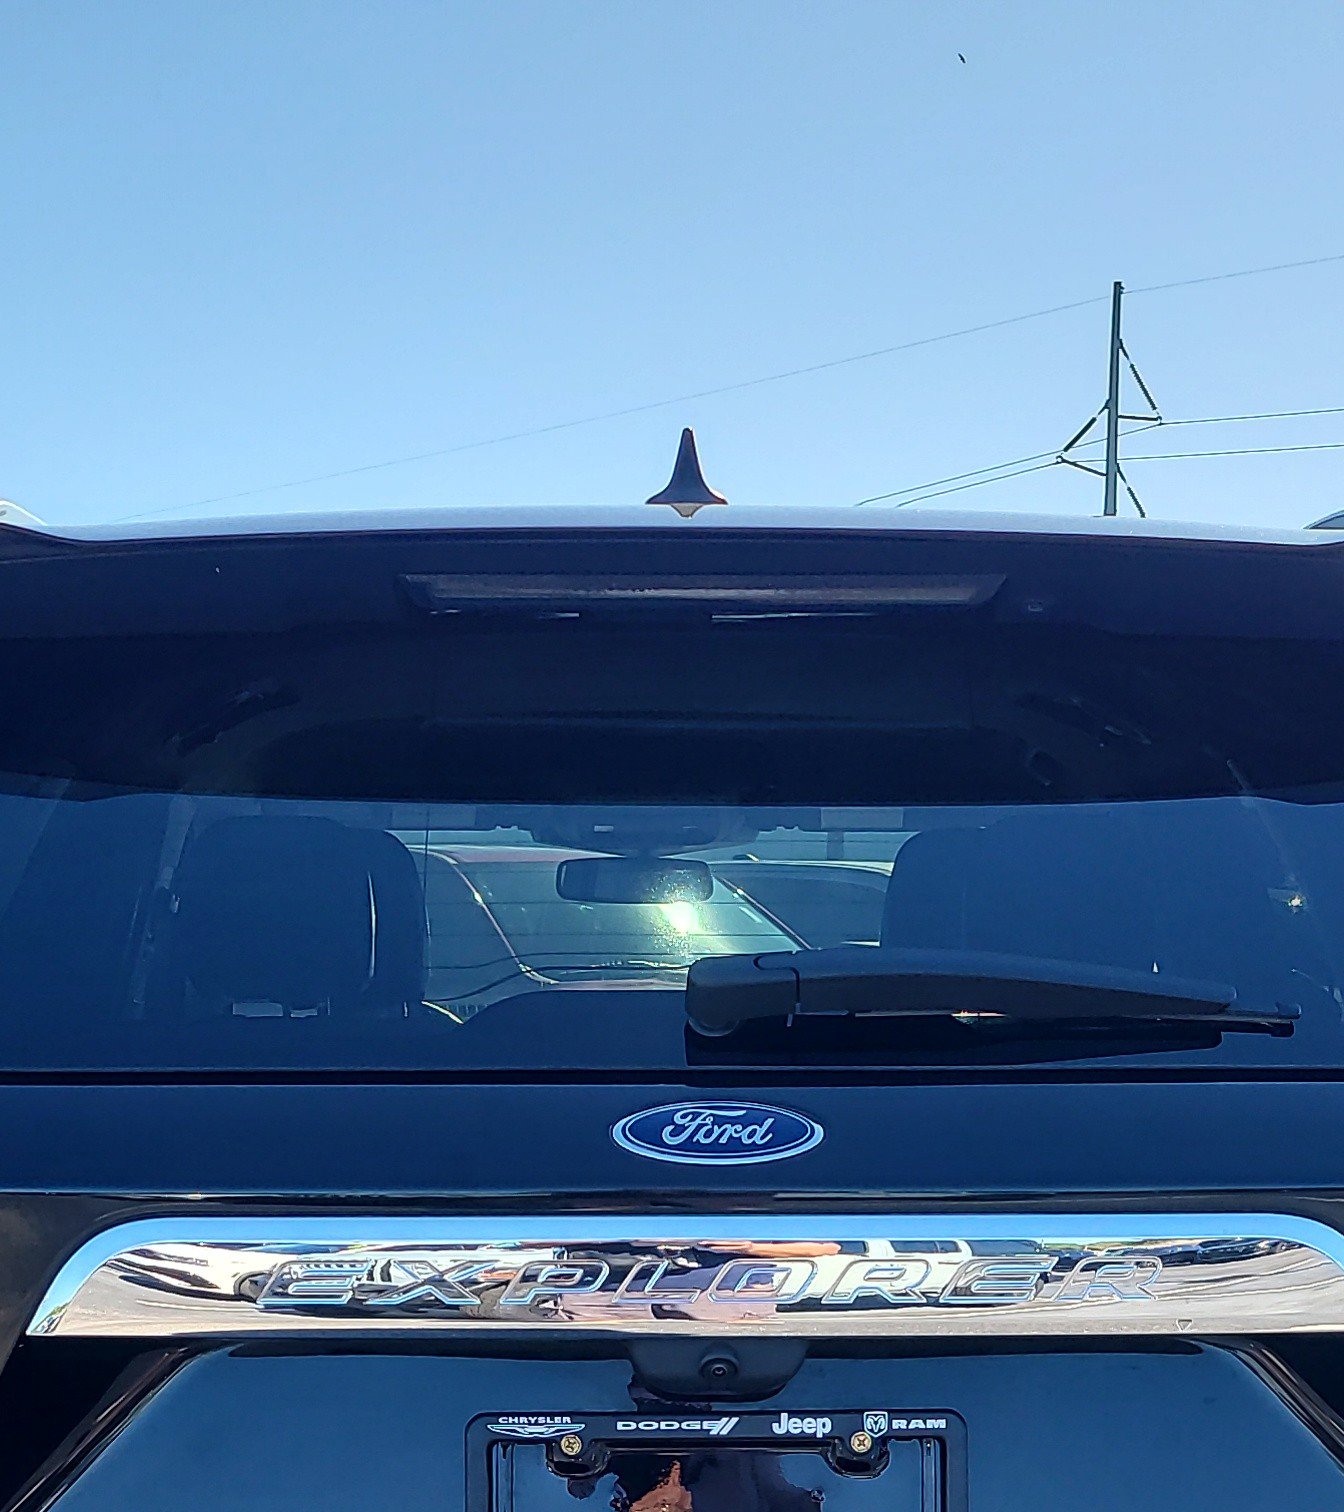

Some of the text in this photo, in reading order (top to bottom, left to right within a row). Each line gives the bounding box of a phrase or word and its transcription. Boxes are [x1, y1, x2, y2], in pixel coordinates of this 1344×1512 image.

[661, 1108, 775, 1145] Ford
[255, 1254, 1164, 1305] EXPLORER
[498, 1412, 948, 1438] CHRYSLER DODGE Jeep RAM
